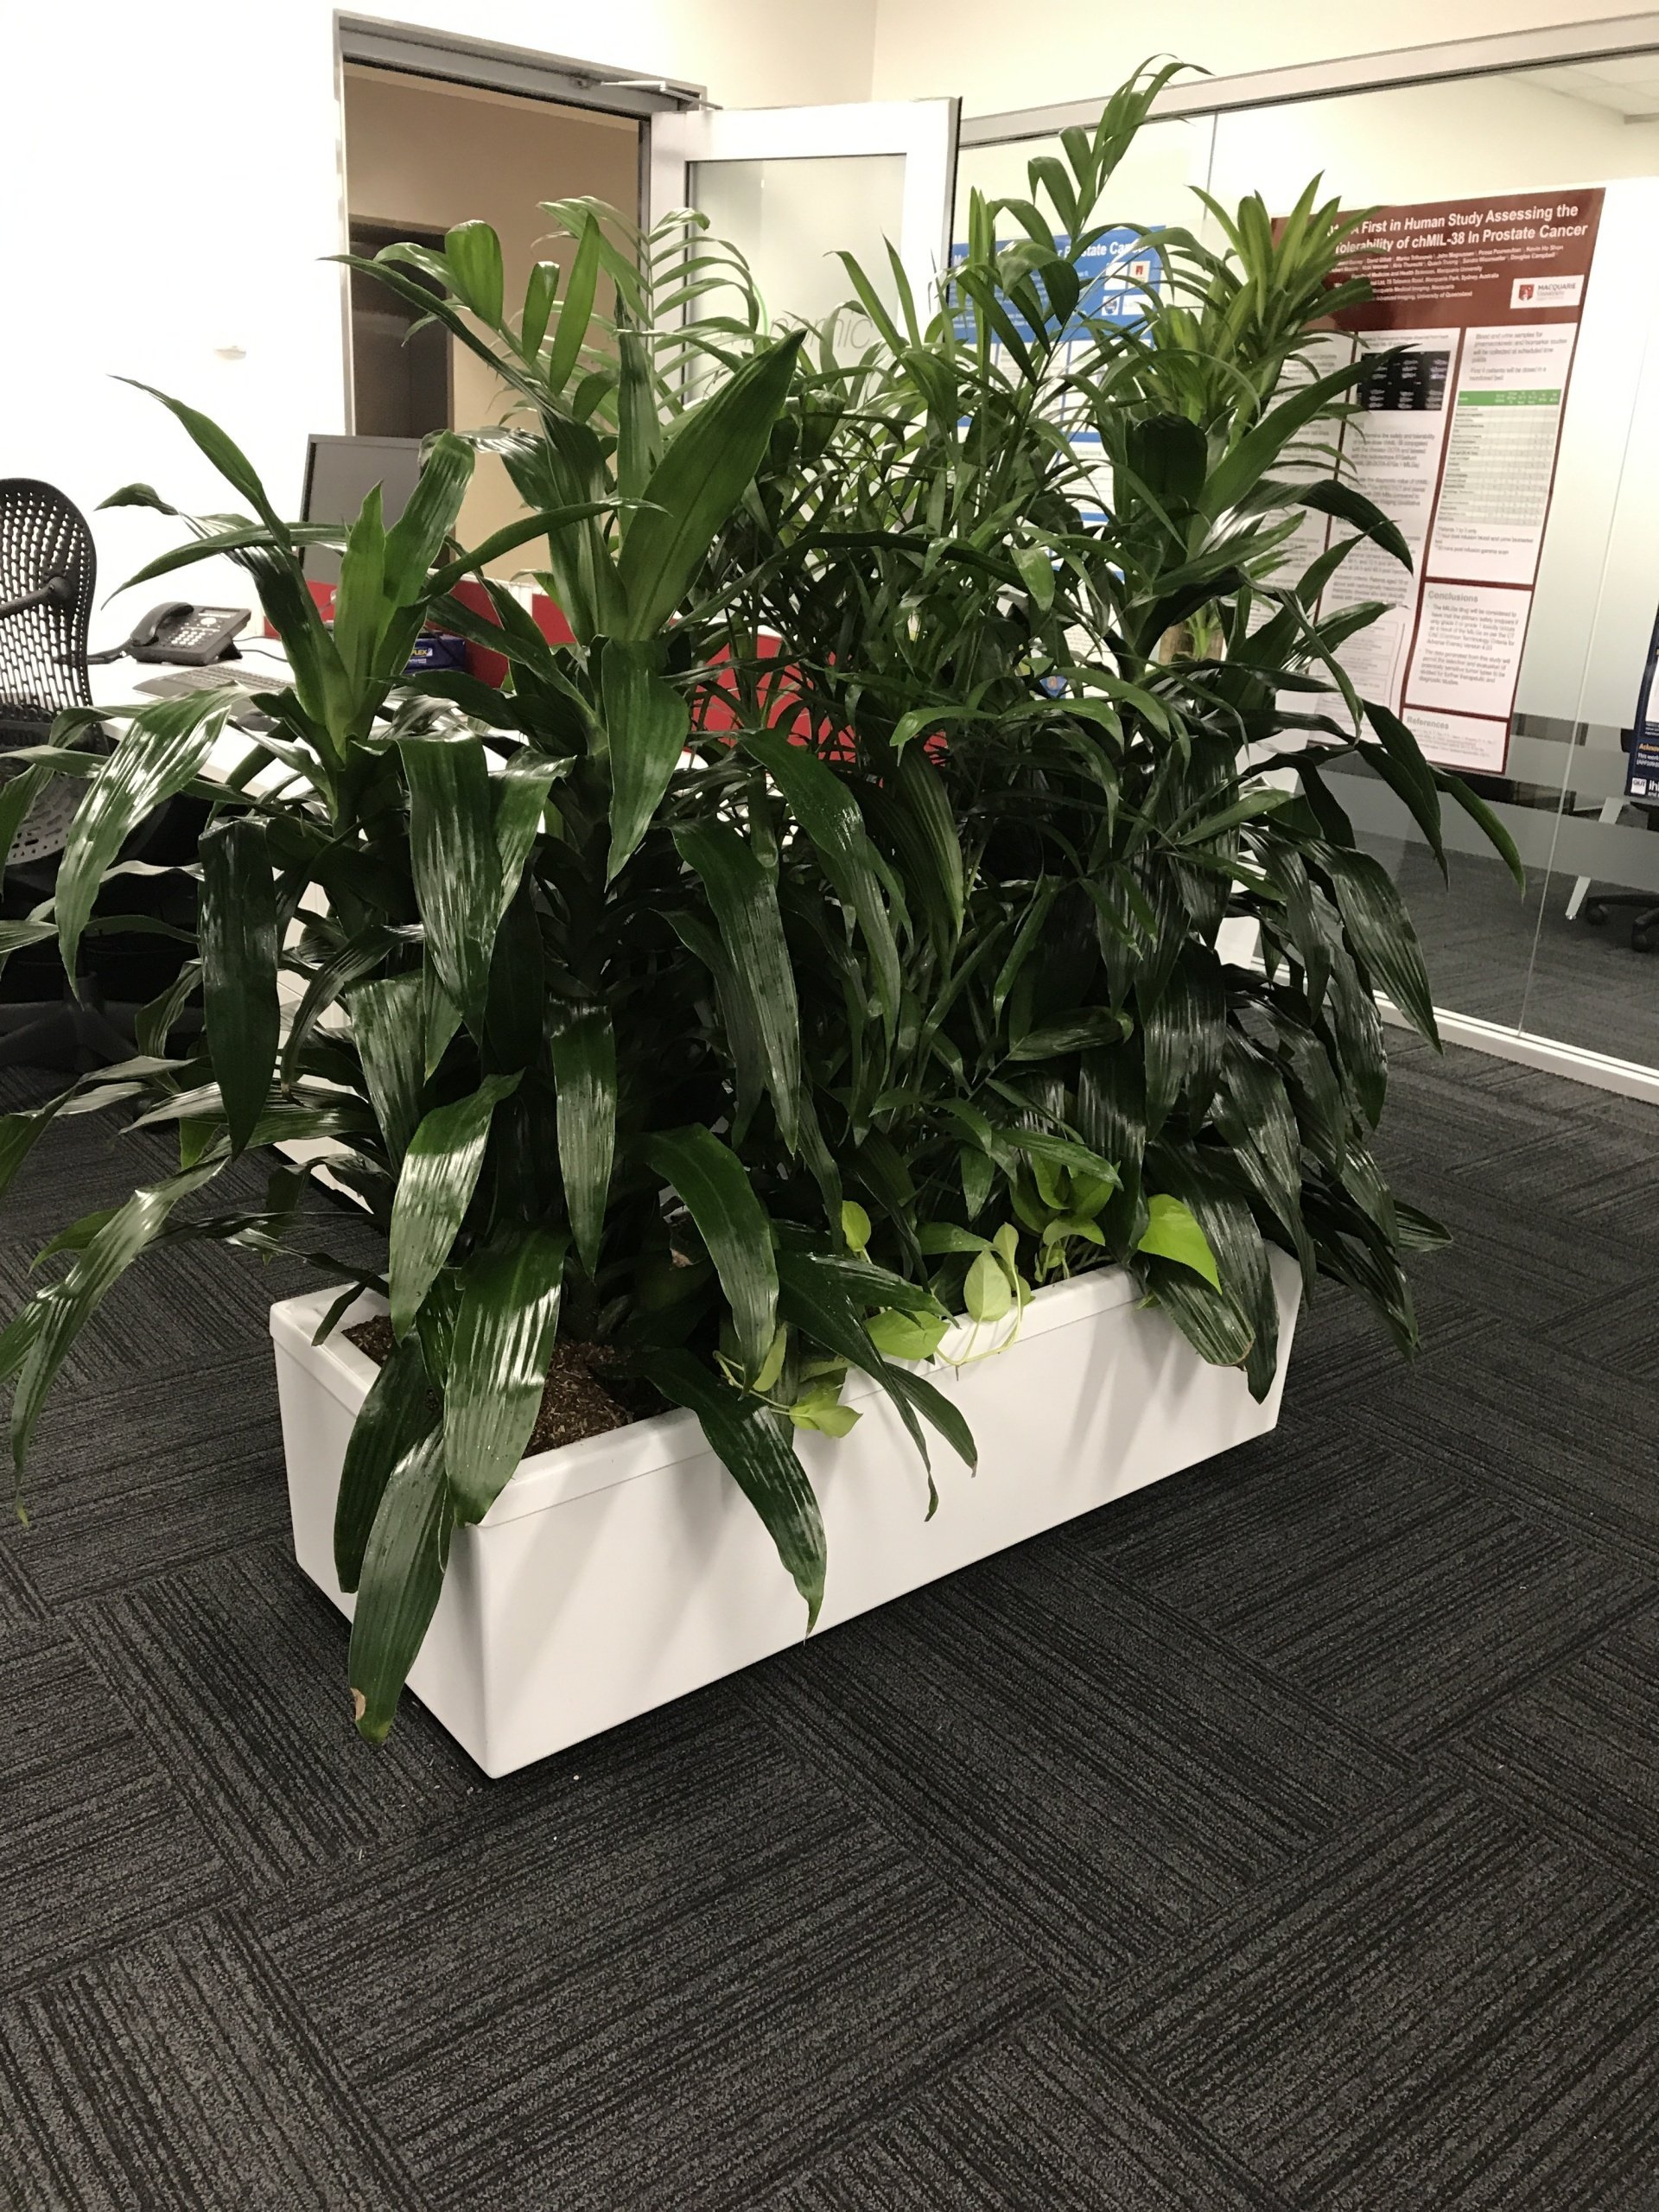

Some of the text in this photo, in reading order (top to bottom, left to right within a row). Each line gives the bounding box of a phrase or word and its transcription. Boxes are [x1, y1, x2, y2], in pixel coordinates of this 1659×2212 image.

[1362, 220, 1388, 233] First
[1389, 219, 1401, 232] in
[1404, 216, 1446, 230] Human
[1448, 212, 1484, 227] Study
[1485, 206, 1554, 222] Assessing
[1556, 203, 1579, 217] the
[1396, 236, 1409, 249] of
[1483, 226, 1535, 242] Prostate
[1540, 224, 1588, 238] Cancer
[1537, 283, 1577, 291] MACQUARIE
[1428, 590, 1478, 603] Conclusions
[1407, 715, 1449, 729] References
